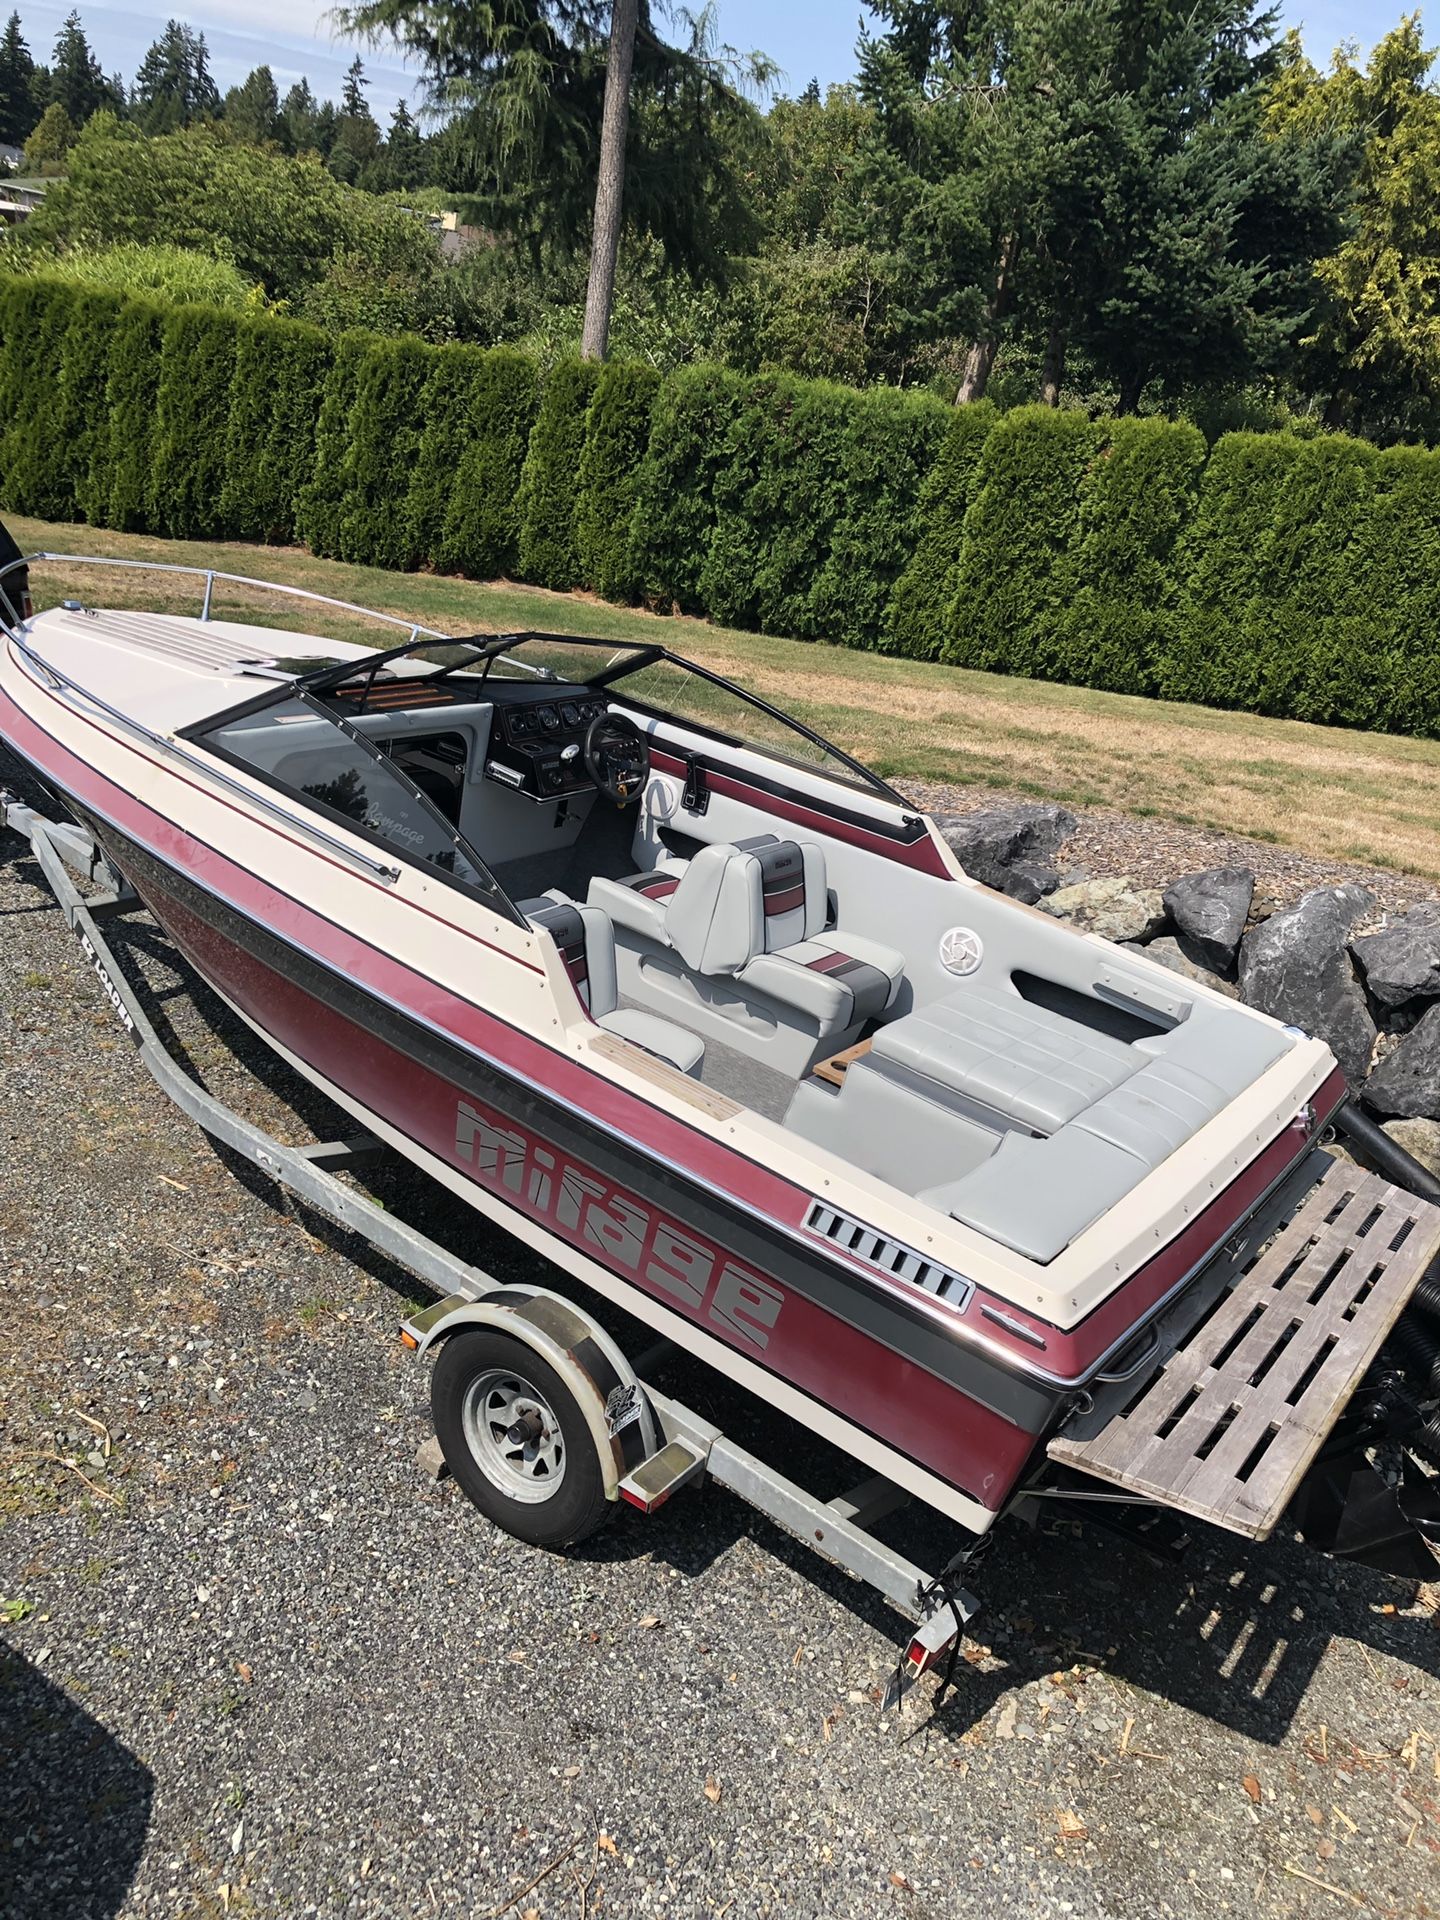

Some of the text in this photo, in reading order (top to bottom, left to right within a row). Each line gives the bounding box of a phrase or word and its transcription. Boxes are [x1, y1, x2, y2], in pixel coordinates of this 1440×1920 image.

[360, 801, 425, 846] Rampage
[94, 958, 135, 1033] LOADER
[455, 1100, 785, 1351] mirage
